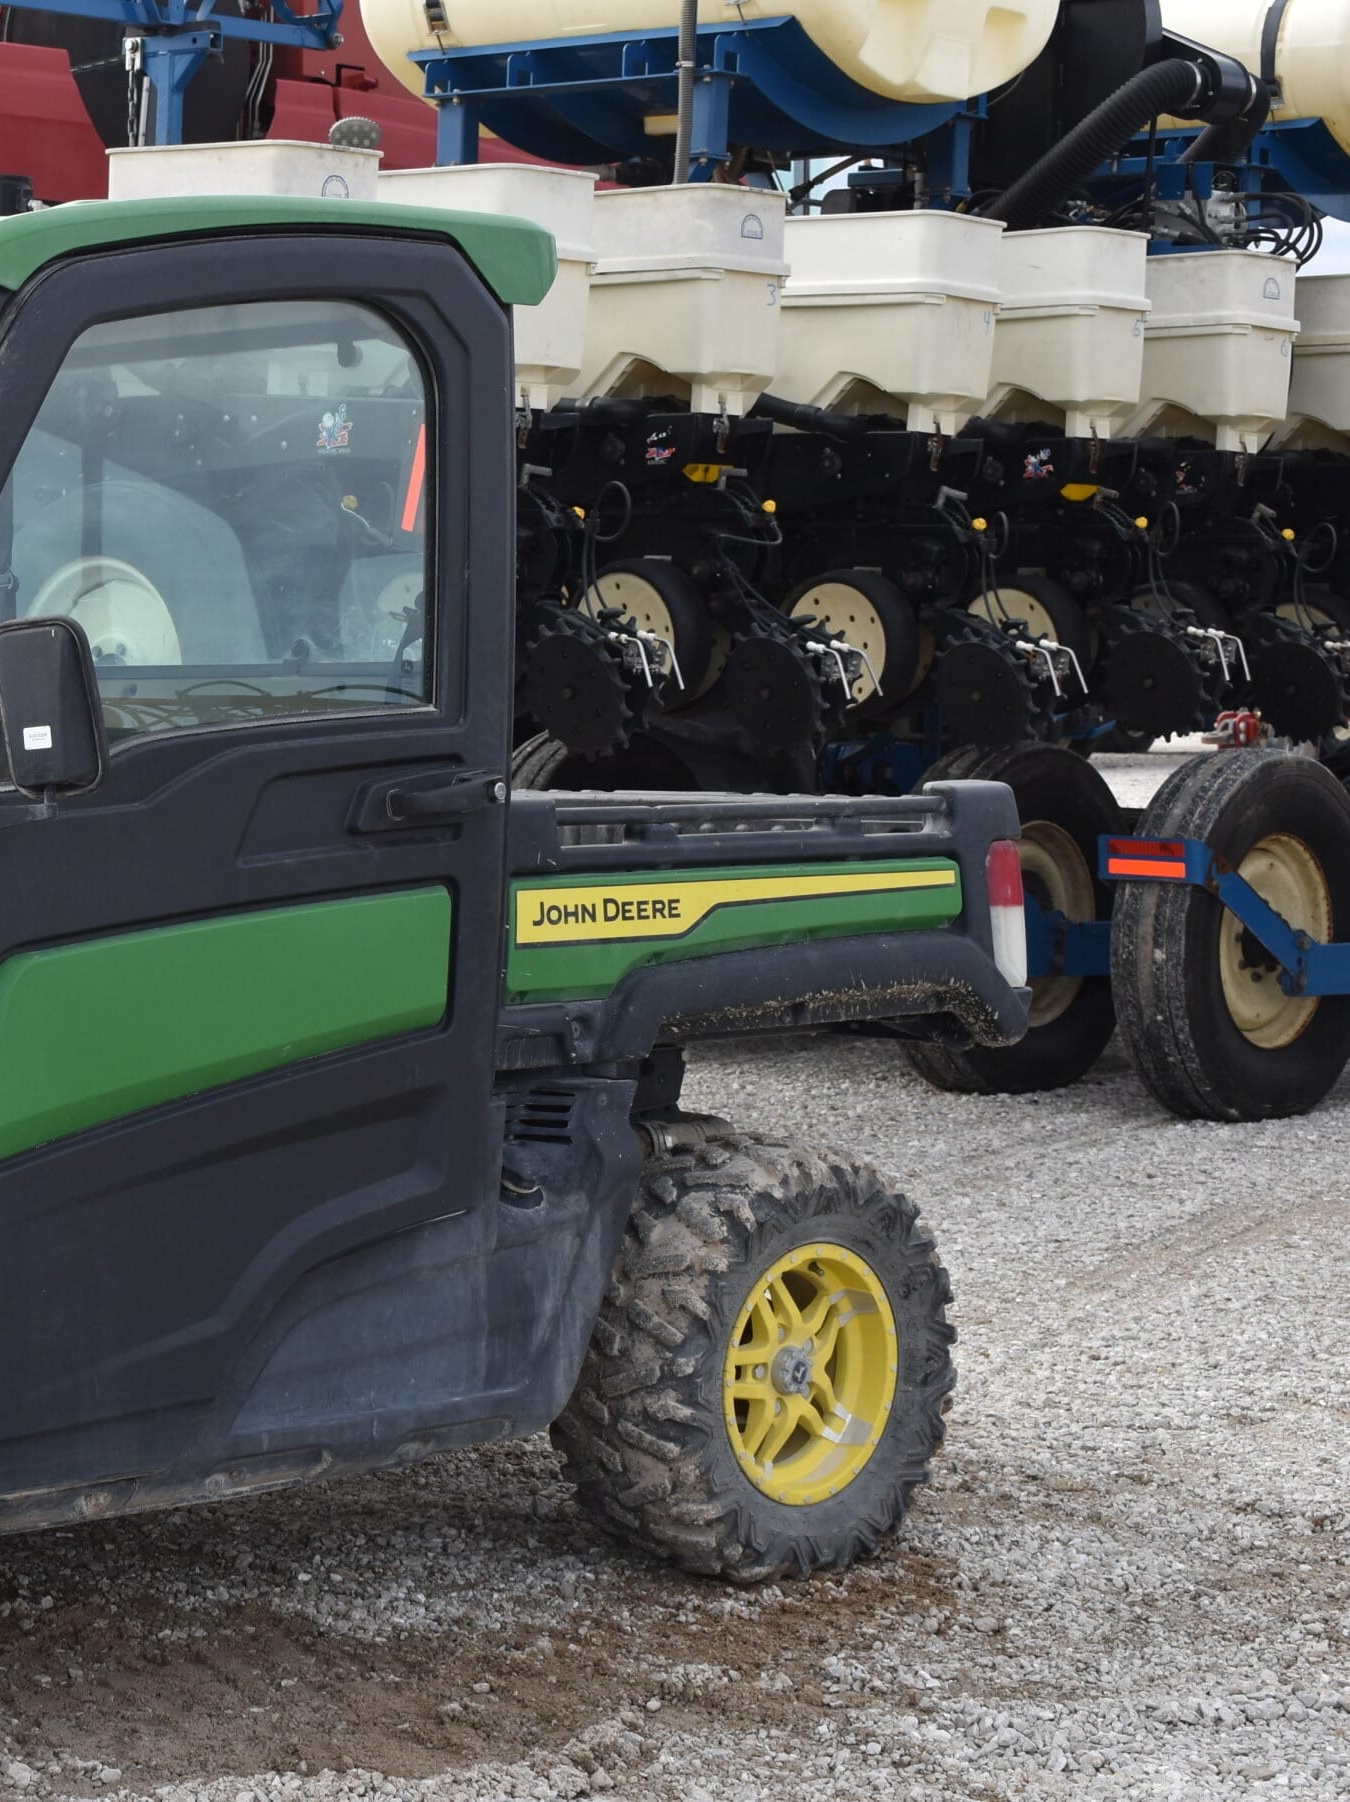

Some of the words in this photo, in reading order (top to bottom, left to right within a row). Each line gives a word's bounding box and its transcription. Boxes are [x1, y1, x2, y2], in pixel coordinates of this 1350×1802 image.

[766, 283, 777, 307] 3
[532, 901, 597, 927] JOHN
[602, 897, 682, 923] DEERE
